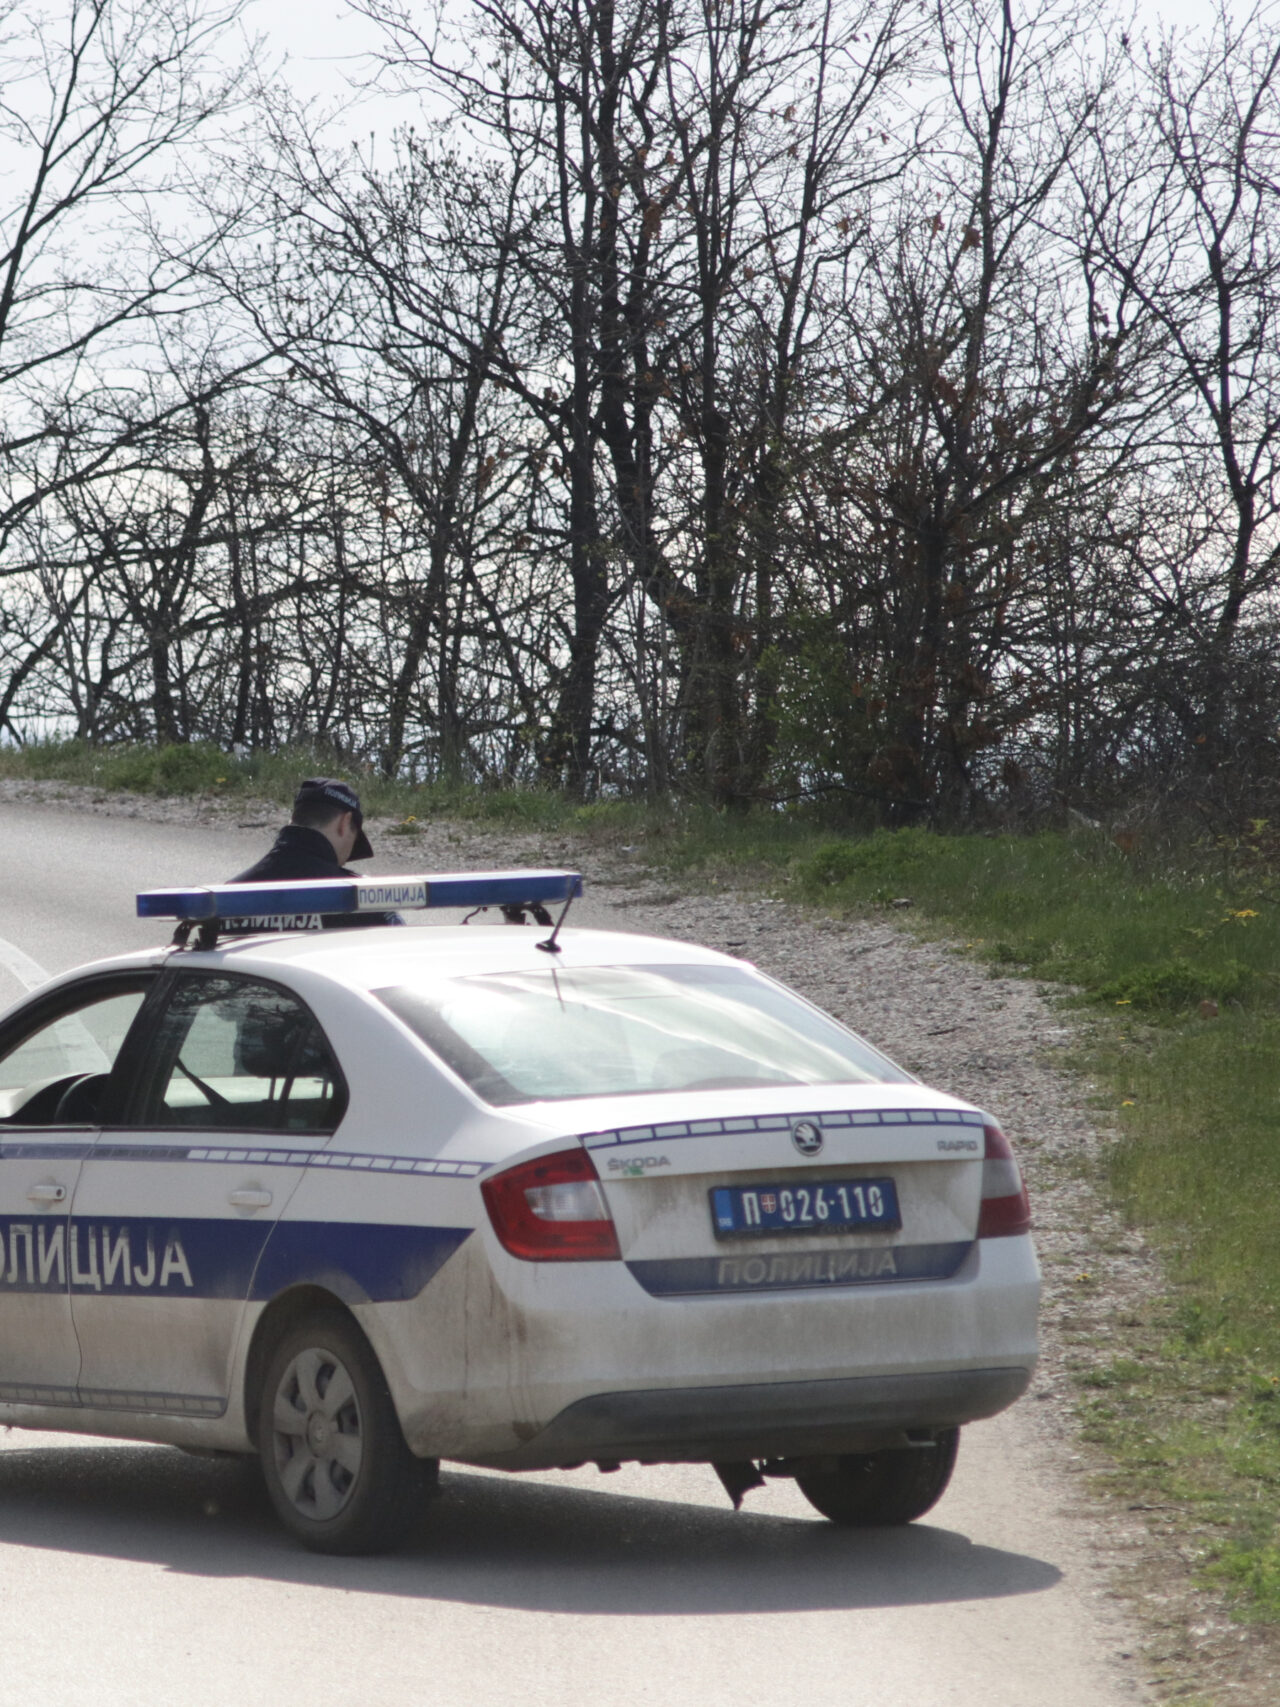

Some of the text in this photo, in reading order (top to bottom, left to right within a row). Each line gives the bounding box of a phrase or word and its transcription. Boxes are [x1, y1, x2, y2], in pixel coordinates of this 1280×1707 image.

[359, 886, 425, 904] ПОЛИЦИЈА
[607, 1155, 672, 1171] ŠKODA
[742, 1192, 762, 1225] П
[718, 1250, 897, 1285] ПОЛИЦИЈА
